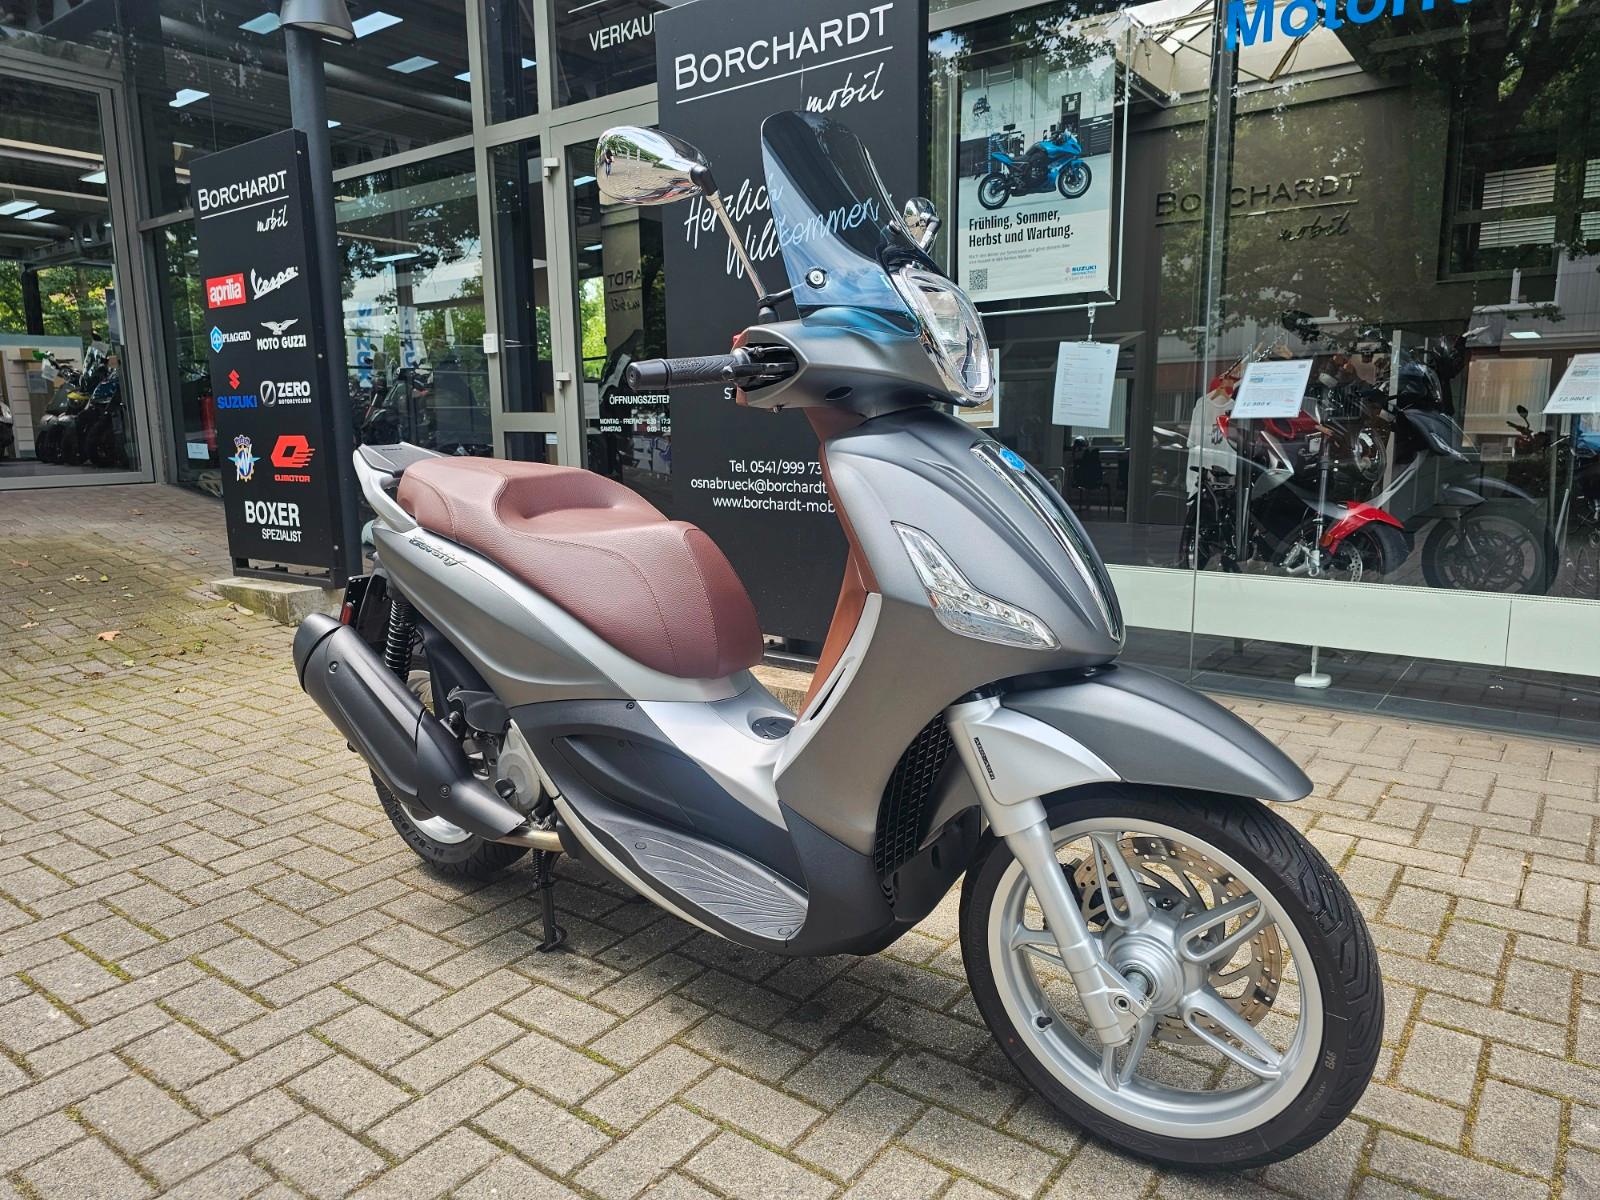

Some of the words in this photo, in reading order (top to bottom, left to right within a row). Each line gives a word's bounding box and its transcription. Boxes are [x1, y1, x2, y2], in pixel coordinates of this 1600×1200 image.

[588, 13, 656, 52] VERKAU
[675, 3, 894, 90] BORCHARDT
[806, 62, 885, 113] mobil
[198, 170, 287, 211] BORCHARDT
[1155, 171, 1361, 217] BOCHARDT
[257, 204, 288, 232] mobil
[969, 215, 1013, 231] Frühling,
[1016, 209, 1061, 225] Sommer,
[969, 234, 1002, 248] Herbst
[1005, 230, 1024, 243] und
[1027, 224, 1074, 241] Wartung.
[209, 278, 242, 305] aprilia
[250, 266, 299, 300] Vespa
[222, 331, 251, 343] PIAGGIO
[256, 336, 280, 351] MOTO
[281, 335, 307, 348] GUZZI
[217, 395, 257, 409] SUZUKI
[277, 381, 311, 398] ZERO
[729, 459, 748, 473] Tel.
[750, 459, 805, 475] 0541/999
[690, 477, 828, 494] osnabrueck@borchardt
[244, 500, 300, 527] BOXER
[261, 528, 302, 543] SPEZIALIST
